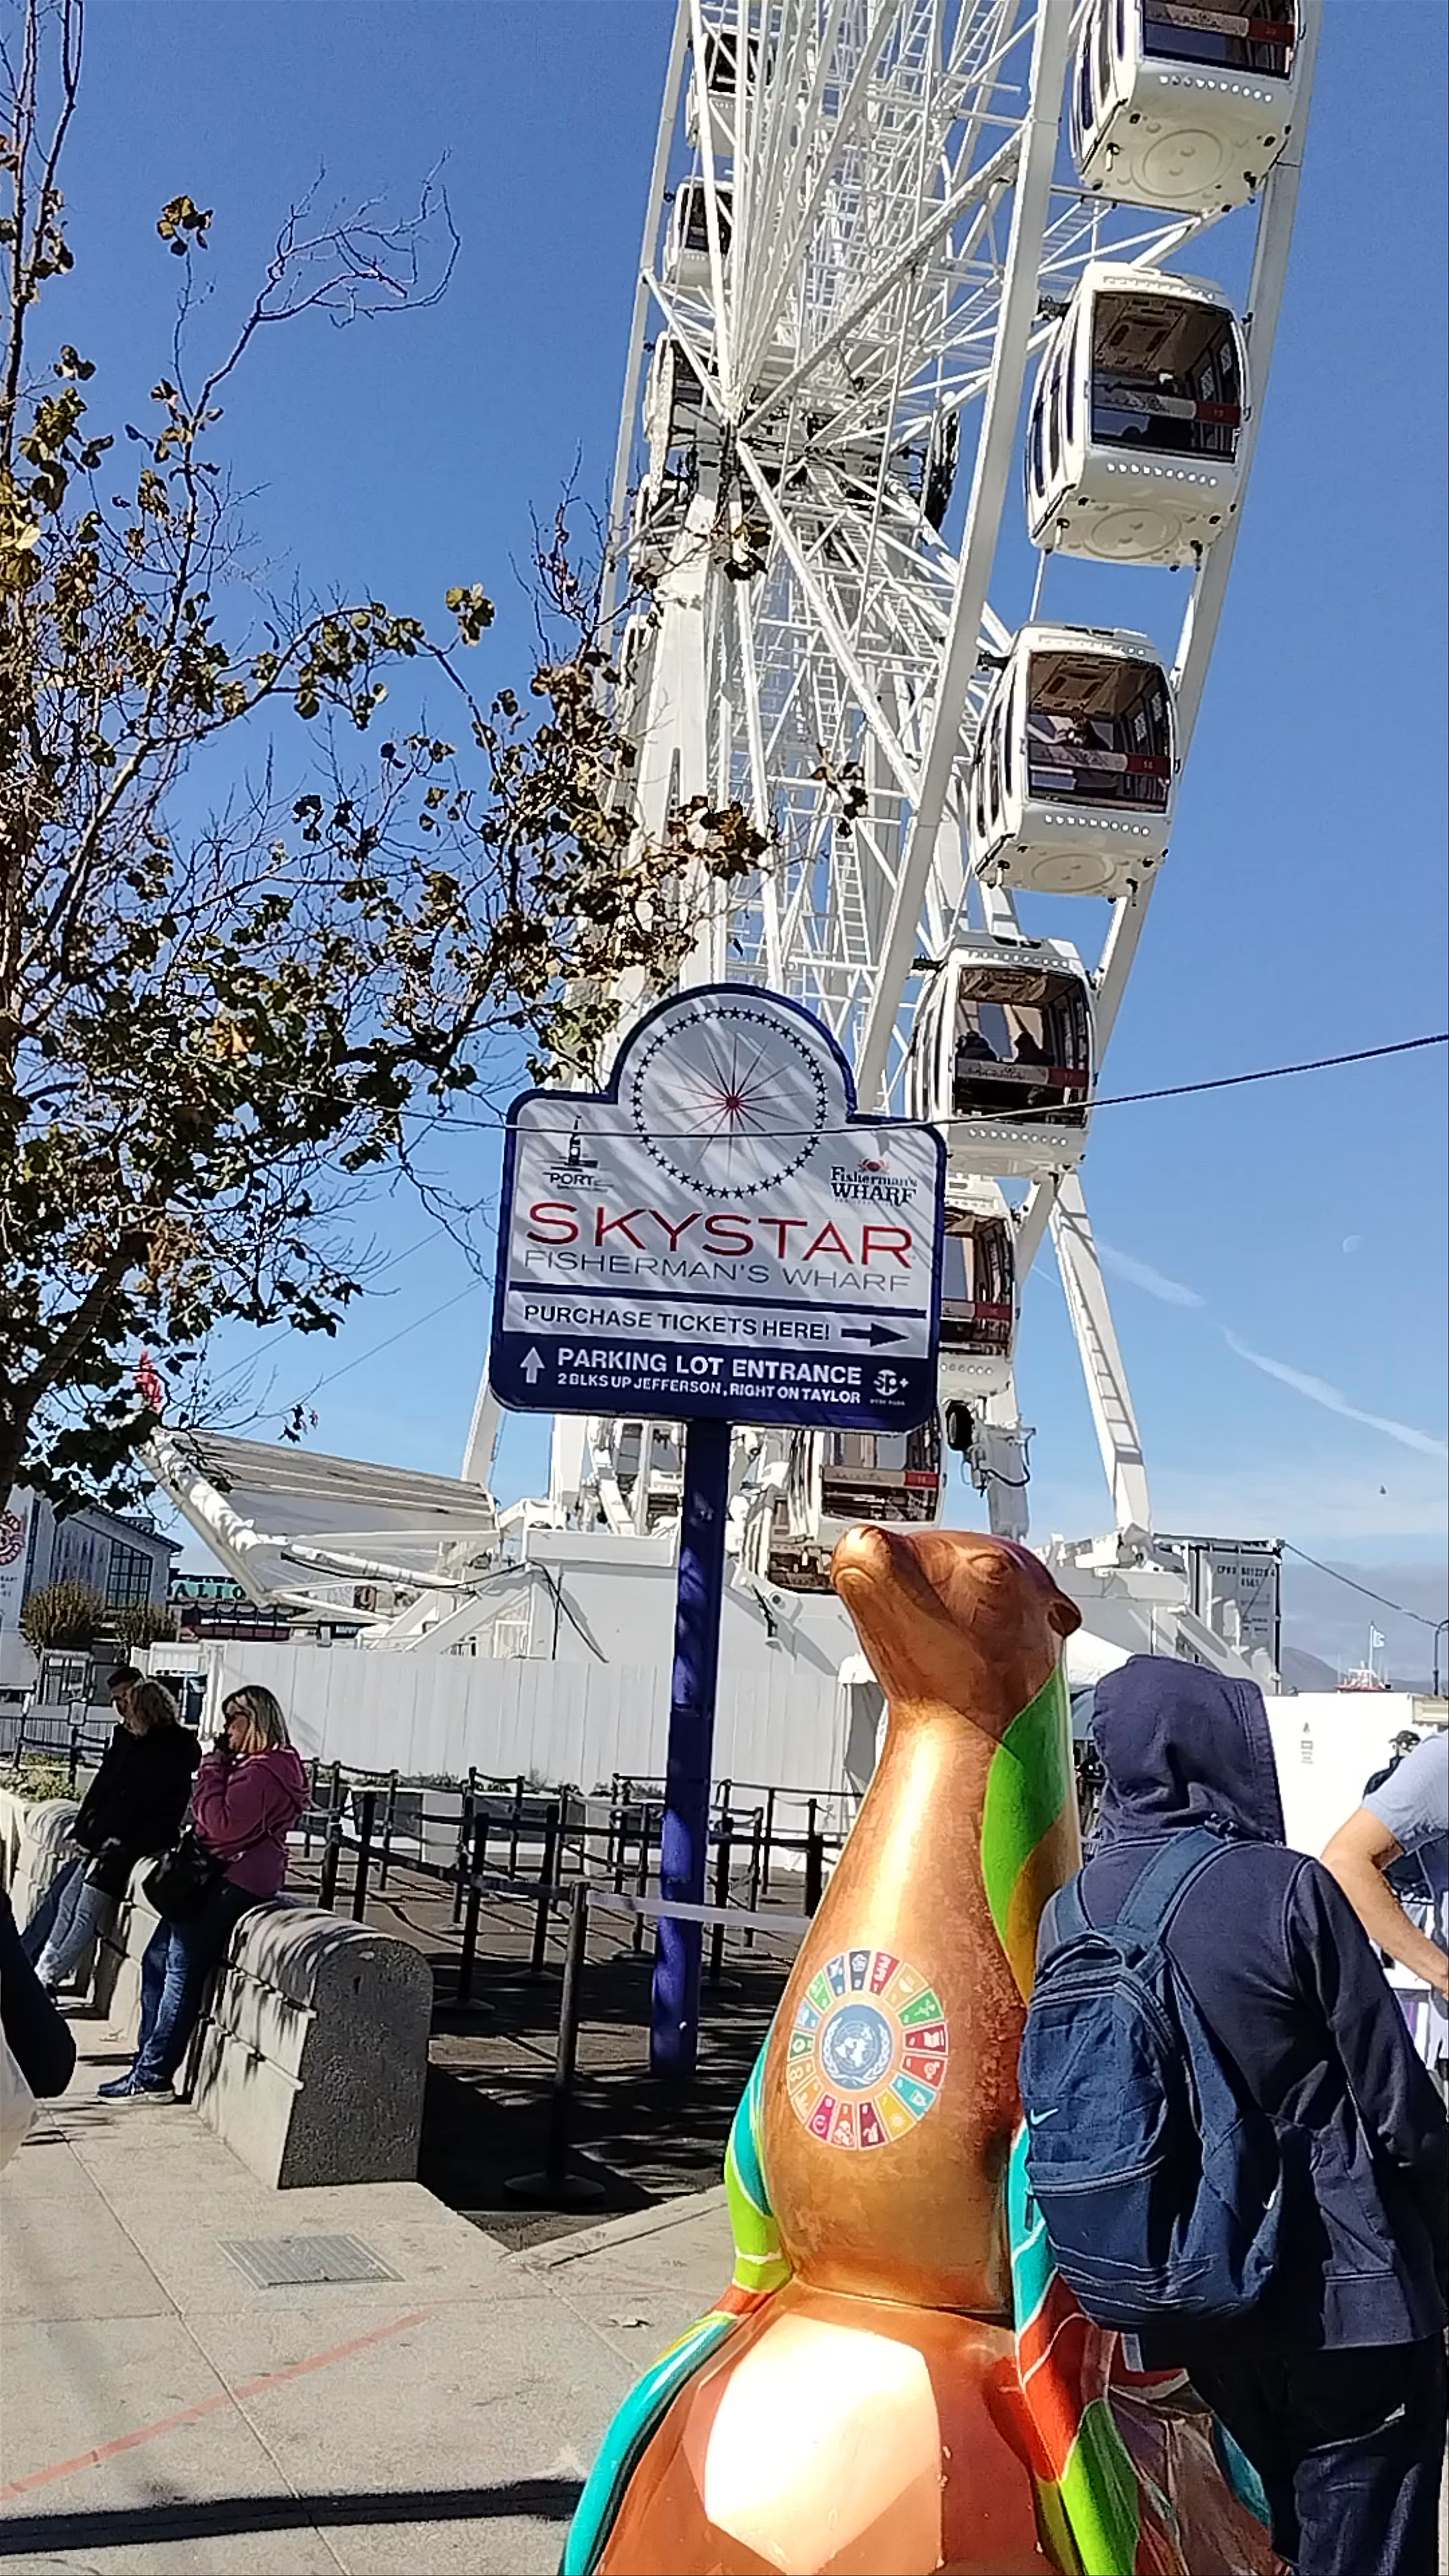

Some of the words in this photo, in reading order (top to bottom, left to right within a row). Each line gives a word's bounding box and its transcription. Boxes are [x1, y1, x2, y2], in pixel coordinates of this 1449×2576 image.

[549, 1172, 595, 1186] PORT
[831, 1183, 917, 1207] WHARF
[526, 1202, 912, 1269] SKYSTAR
[525, 1250, 769, 1283] FISHERMAN'S
[783, 1267, 911, 1292] WHARF
[525, 1305, 652, 1328] PURCHASE
[658, 1313, 757, 1335] TICKETS
[763, 1320, 829, 1340] HERE!
[558, 1347, 667, 1372] PARKING
[677, 1355, 724, 1375] LOT
[732, 1359, 862, 1385] ENTRANCE
[557, 1373, 567, 1385] 2
[569, 1373, 608, 1387] BLKS
[611, 1376, 632, 1388] UP
[634, 1377, 727, 1396] JEFFERSON,
[730, 1383, 775, 1398] RIGHT
[777, 1387, 799, 1400] ON
[801, 1388, 861, 1404] TAYLOR
